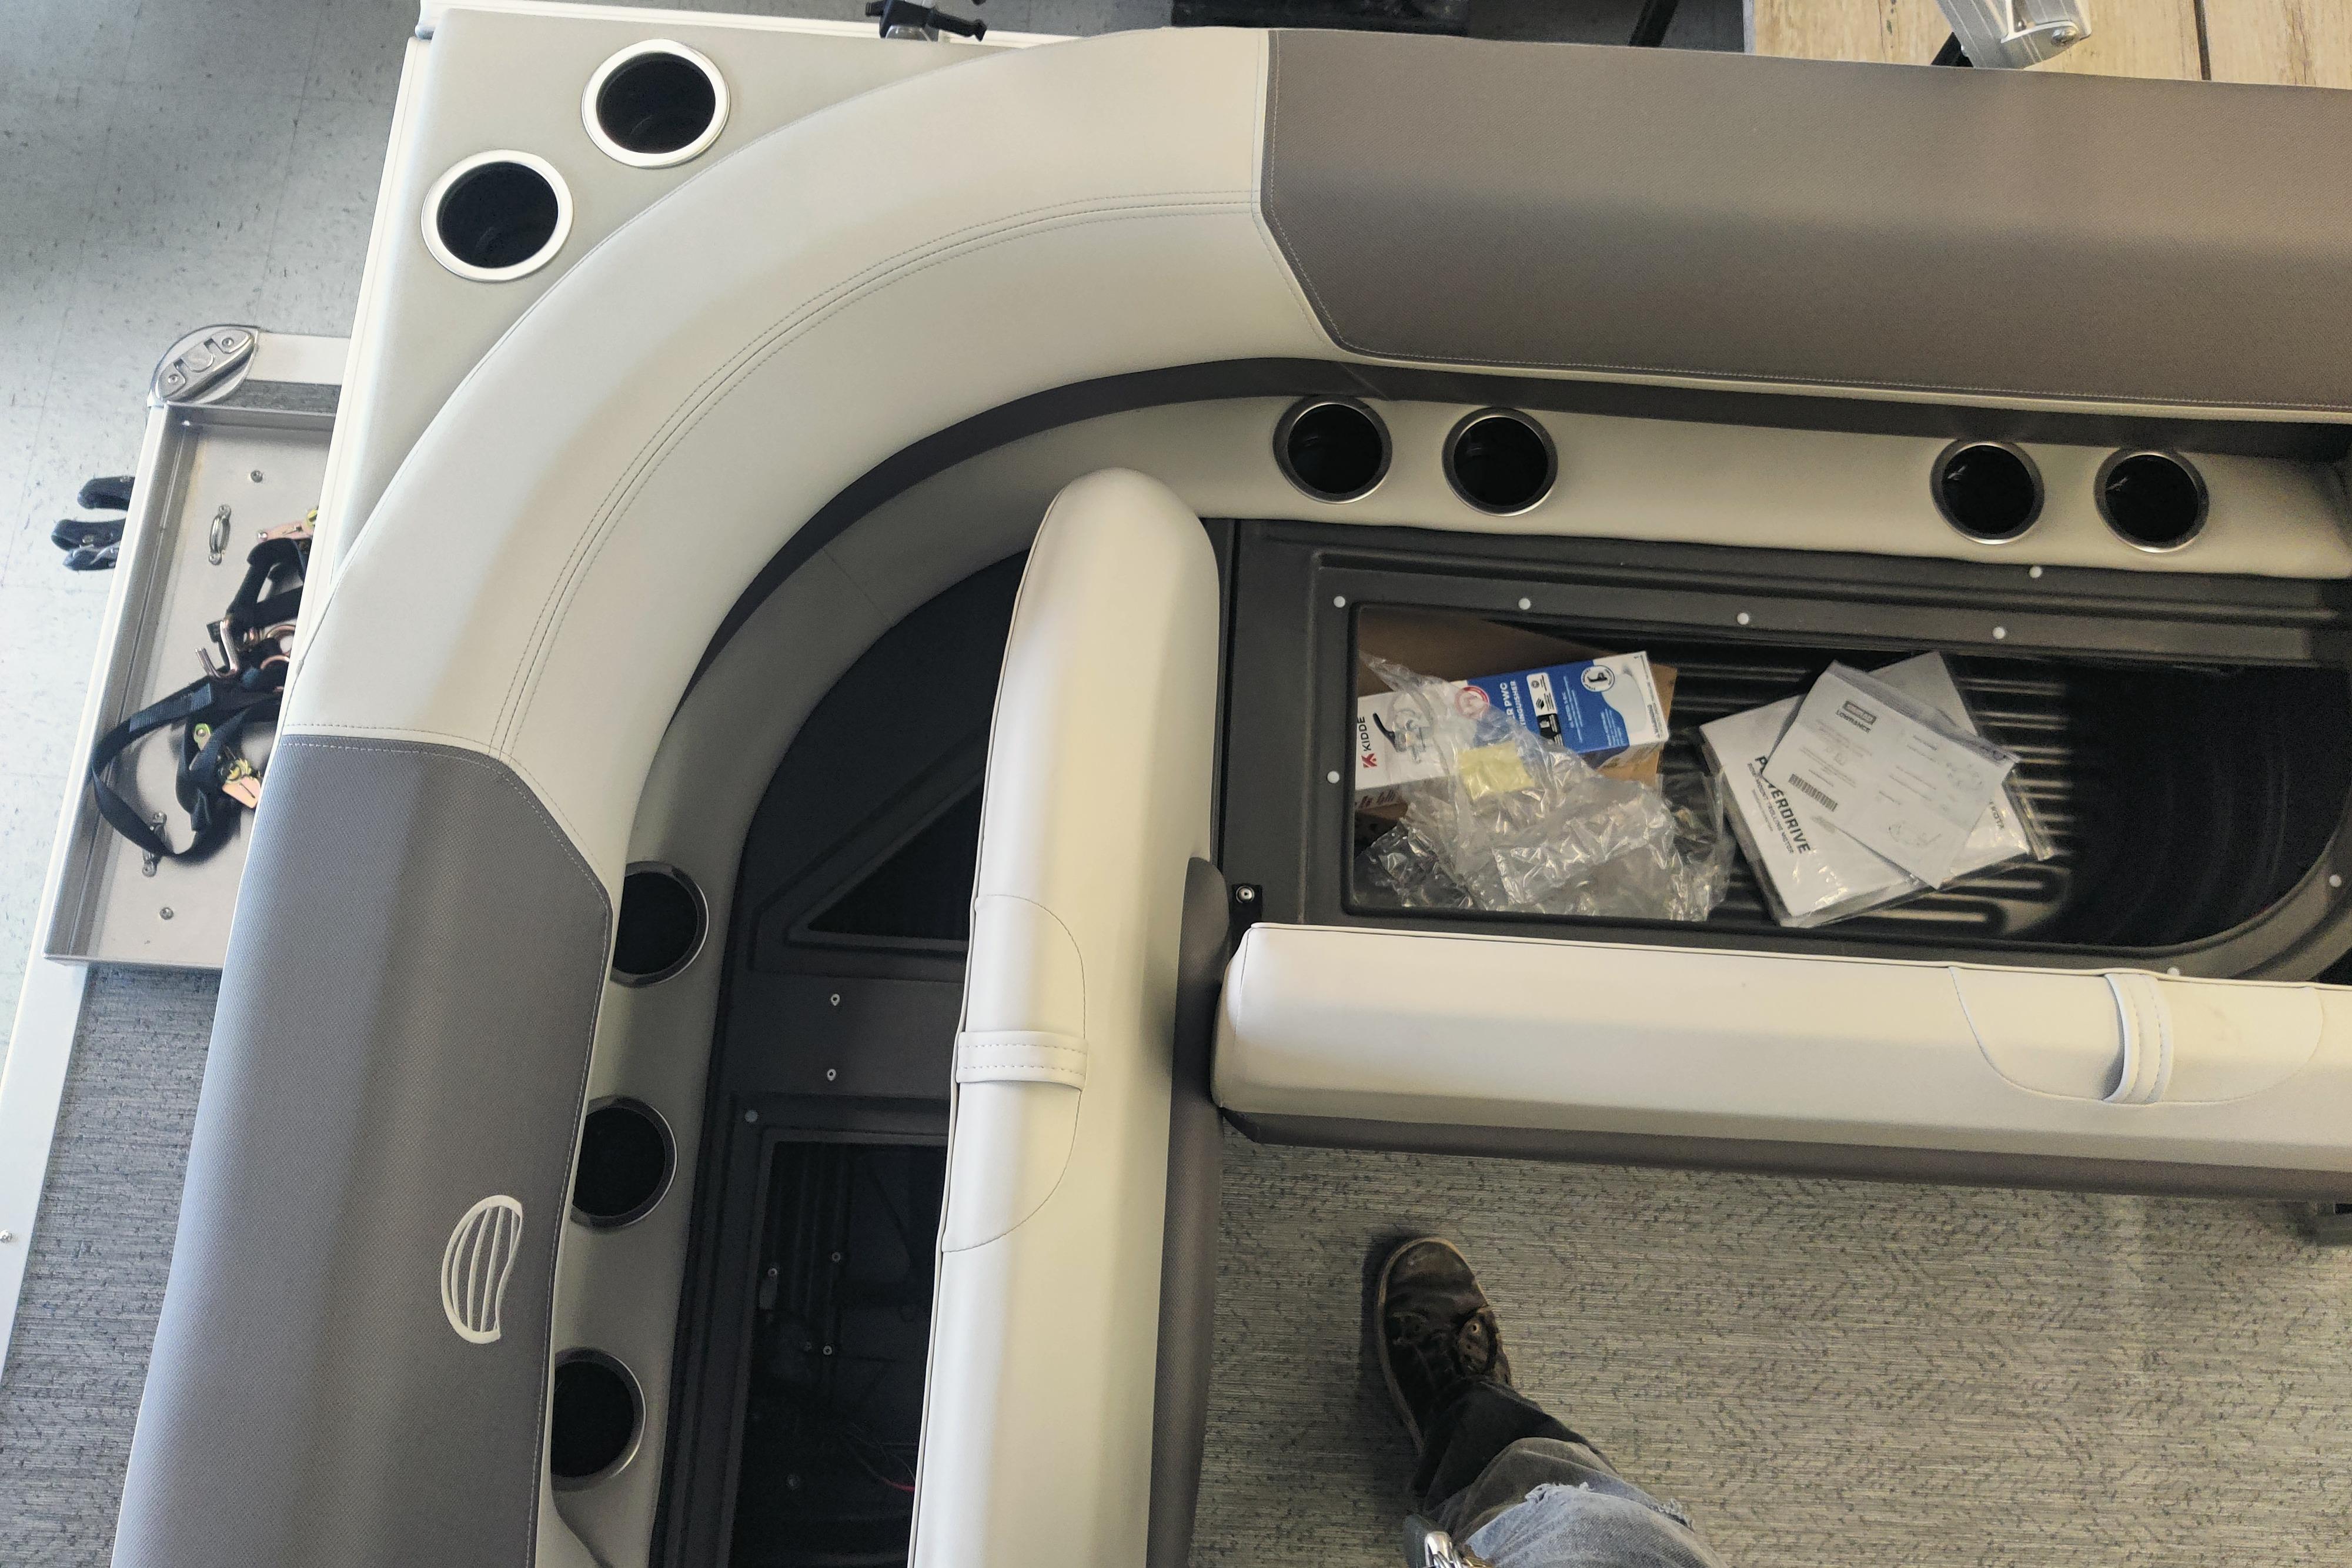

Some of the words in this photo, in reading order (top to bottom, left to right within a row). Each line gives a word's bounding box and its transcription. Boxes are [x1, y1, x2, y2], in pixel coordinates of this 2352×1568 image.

[1500, 682, 1512, 707] PWC
[1510, 681, 1527, 728] TINGUISHER
[1357, 716, 1372, 752] KIDDE
